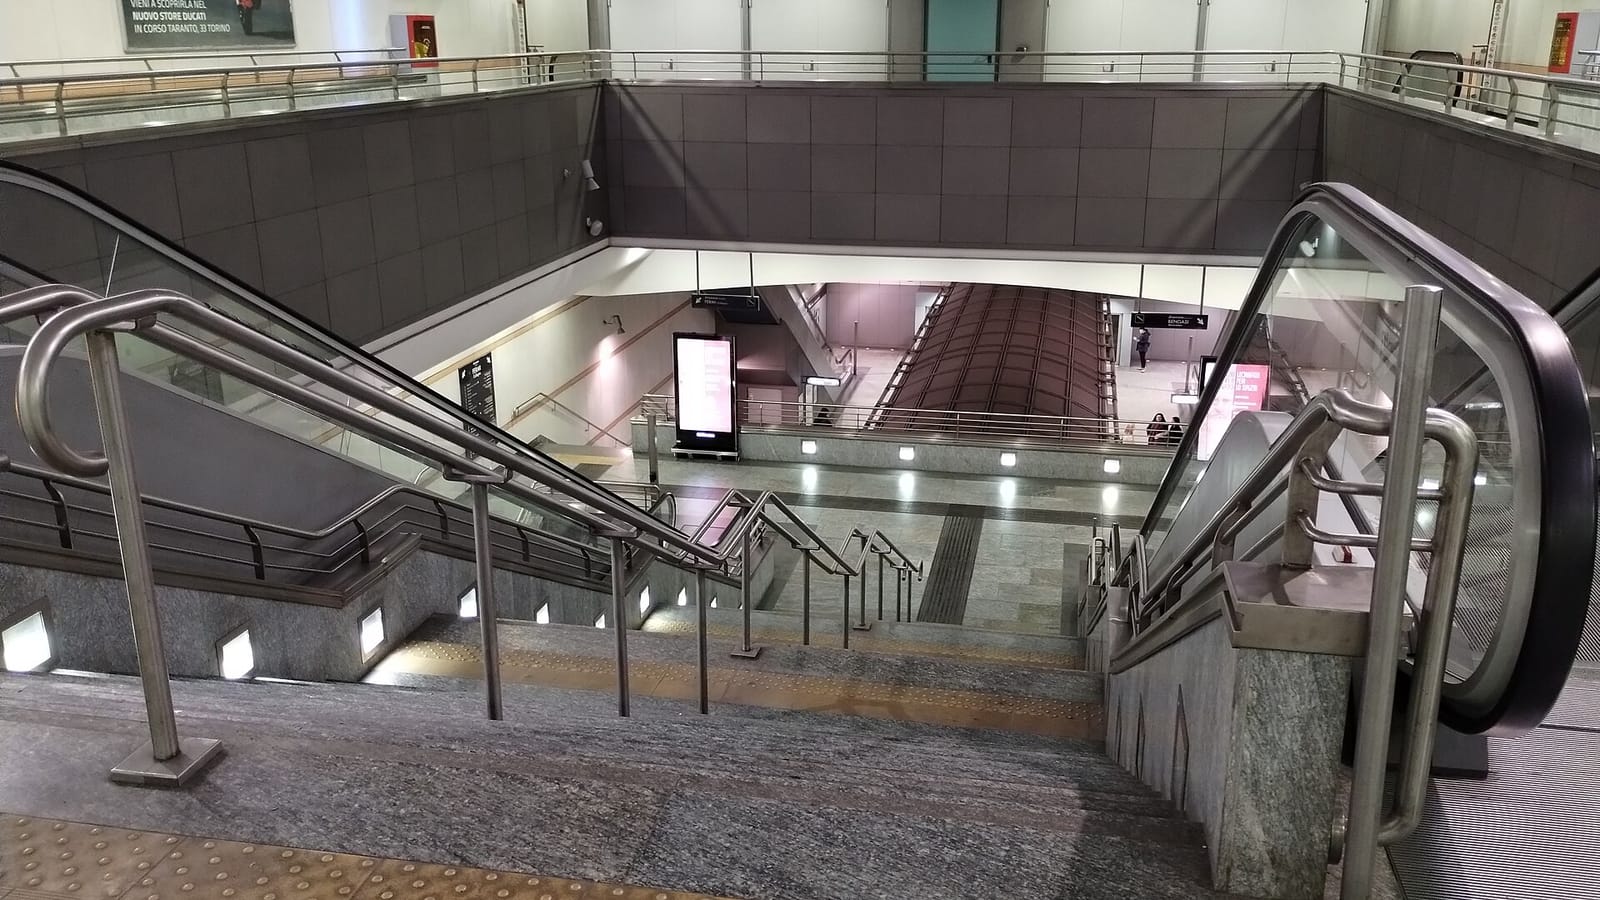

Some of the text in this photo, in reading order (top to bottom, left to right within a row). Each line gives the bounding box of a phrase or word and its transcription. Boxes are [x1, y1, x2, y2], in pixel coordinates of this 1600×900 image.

[130, 0, 207, 8] VIENI A SCOPRIRLA NEL
[132, 11, 207, 21] NUOVO STORE DUCATI
[134, 24, 231, 34] IN CORSO TARANTO, 33 TORINO
